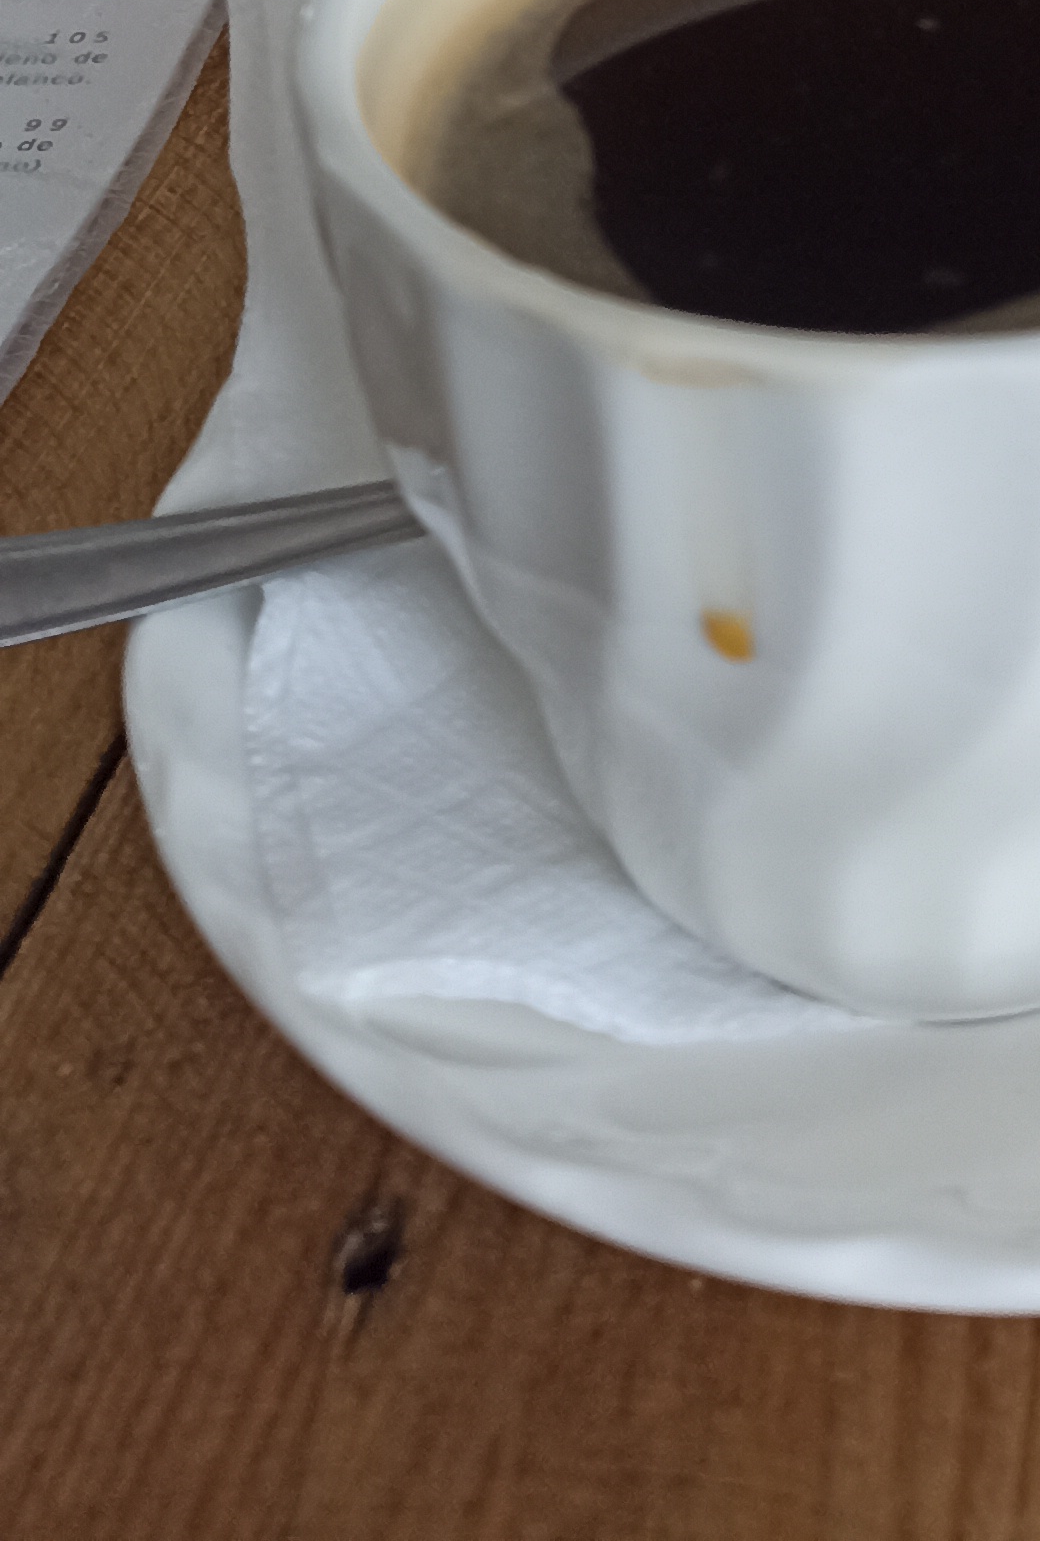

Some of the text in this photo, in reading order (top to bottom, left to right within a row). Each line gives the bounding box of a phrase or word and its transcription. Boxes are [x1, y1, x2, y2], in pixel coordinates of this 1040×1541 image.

[73, 50, 109, 65] de
[23, 117, 69, 133] 99
[16, 137, 54, 152] de
